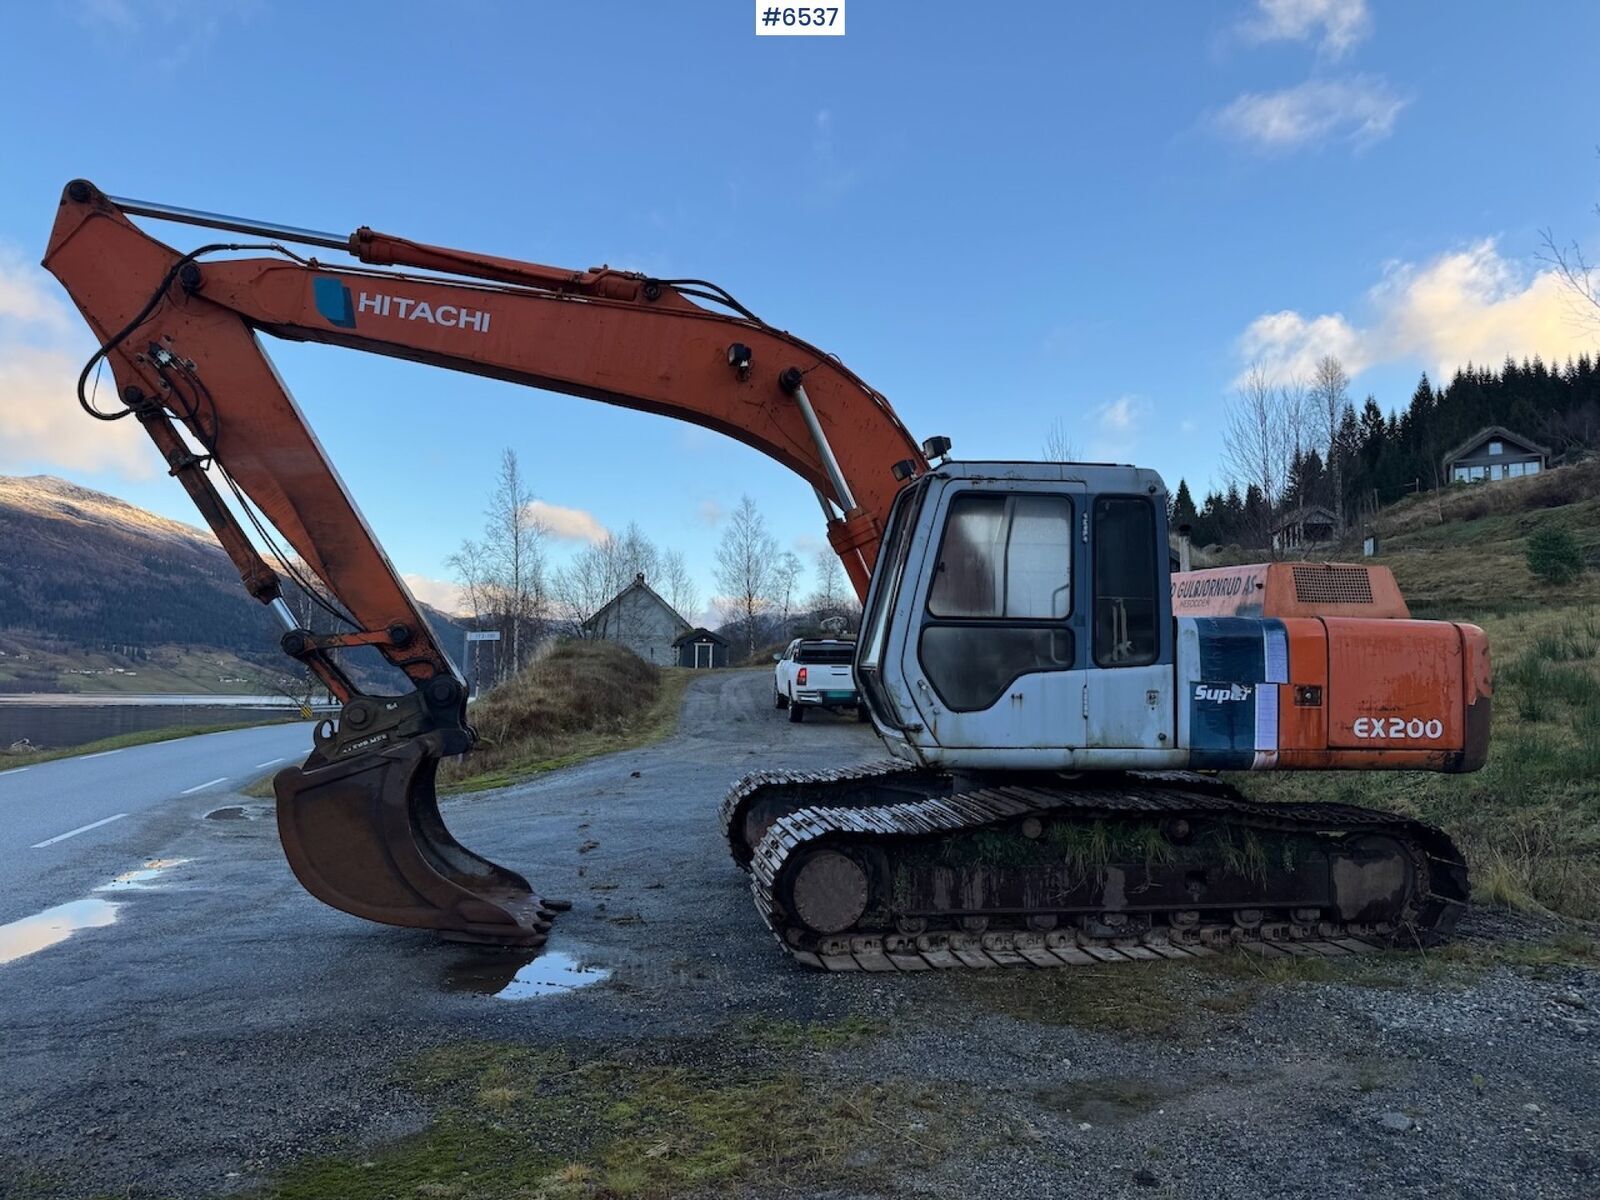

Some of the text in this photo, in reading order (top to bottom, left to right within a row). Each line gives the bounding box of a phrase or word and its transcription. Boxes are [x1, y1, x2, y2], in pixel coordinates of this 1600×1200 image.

[358, 292, 491, 333] HITACHI
[1242, 575, 1257, 595] AS
[1353, 717, 1443, 739] EX200
